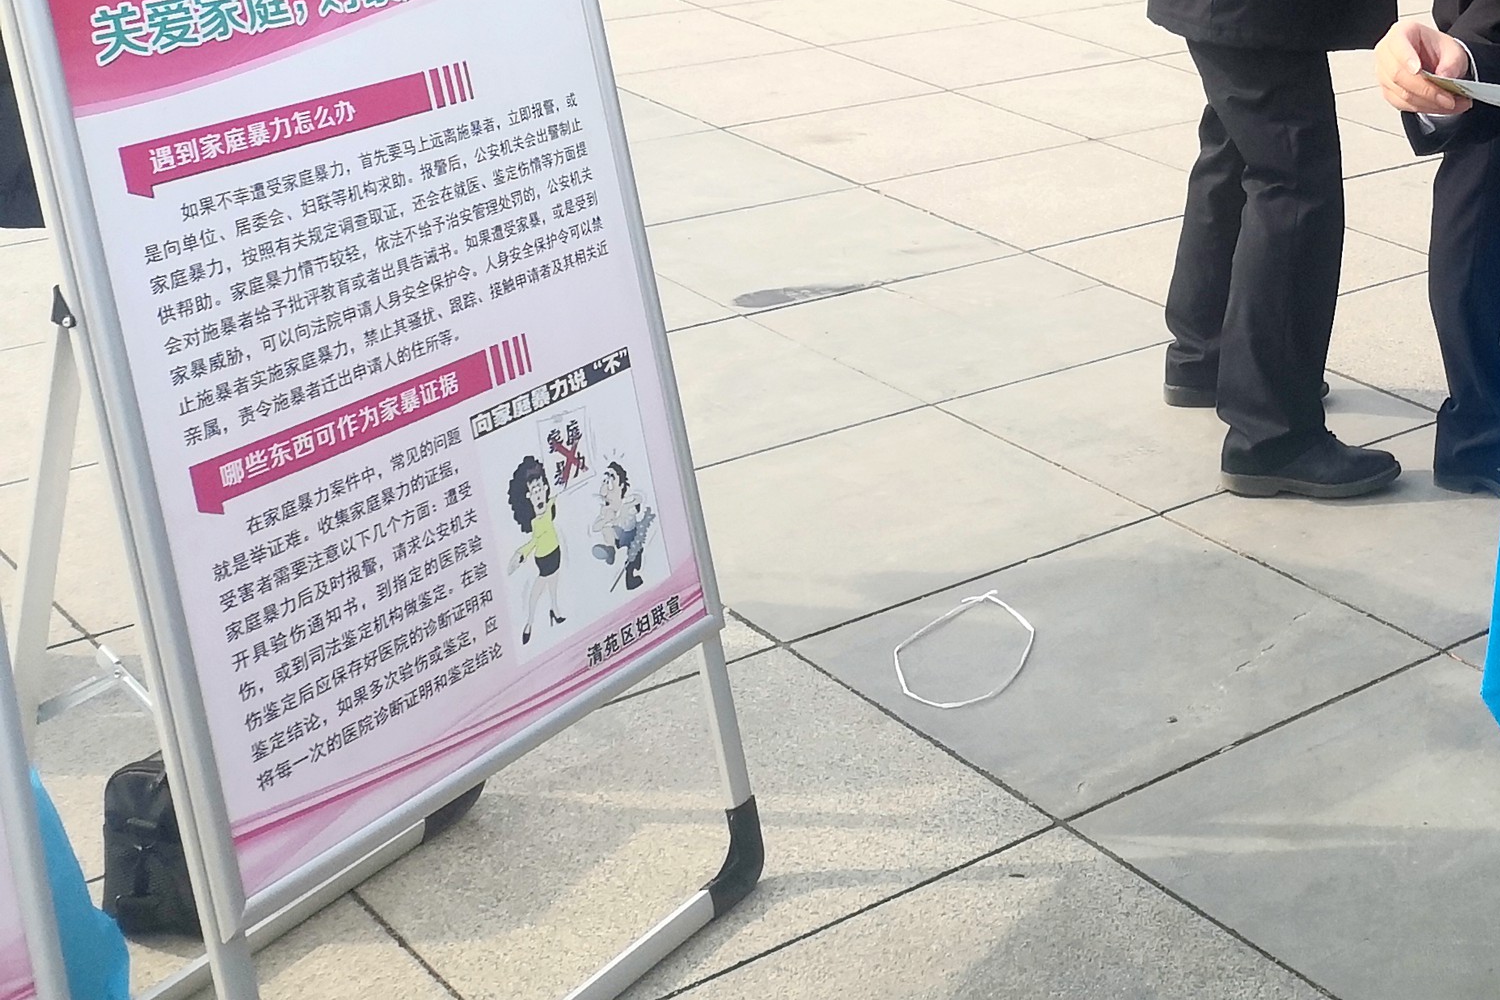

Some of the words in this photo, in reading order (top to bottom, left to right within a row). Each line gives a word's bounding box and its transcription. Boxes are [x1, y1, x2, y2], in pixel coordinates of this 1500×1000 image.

[149, 101, 356, 174] 遇到家庭暴力怎么办
[184, 329, 460, 447] 亲属，责令施暴者迁出申请人的住所等。
[219, 371, 459, 488] 哪些东西可作为家暴证据
[219, 481, 474, 613] 受害者需要注意以下几个方面：遭受
[246, 427, 462, 535] 在家庭暴力案件中，常见的问题
[225, 509, 479, 644] 家庭暴力后及时报警，请求公安机关
[231, 536, 483, 672] 开具验伤通知书，到指定的医院验
[587, 595, 682, 667] 清苑区妇联宣
[244, 590, 493, 733] 伤鉴定后应保存好医院的诊断证明和
[250, 615, 498, 763] 鉴定结论，如果多次验伤或鉴定，应
[256, 642, 503, 792] 将每一次的医院诊断证明和鉴定结论
